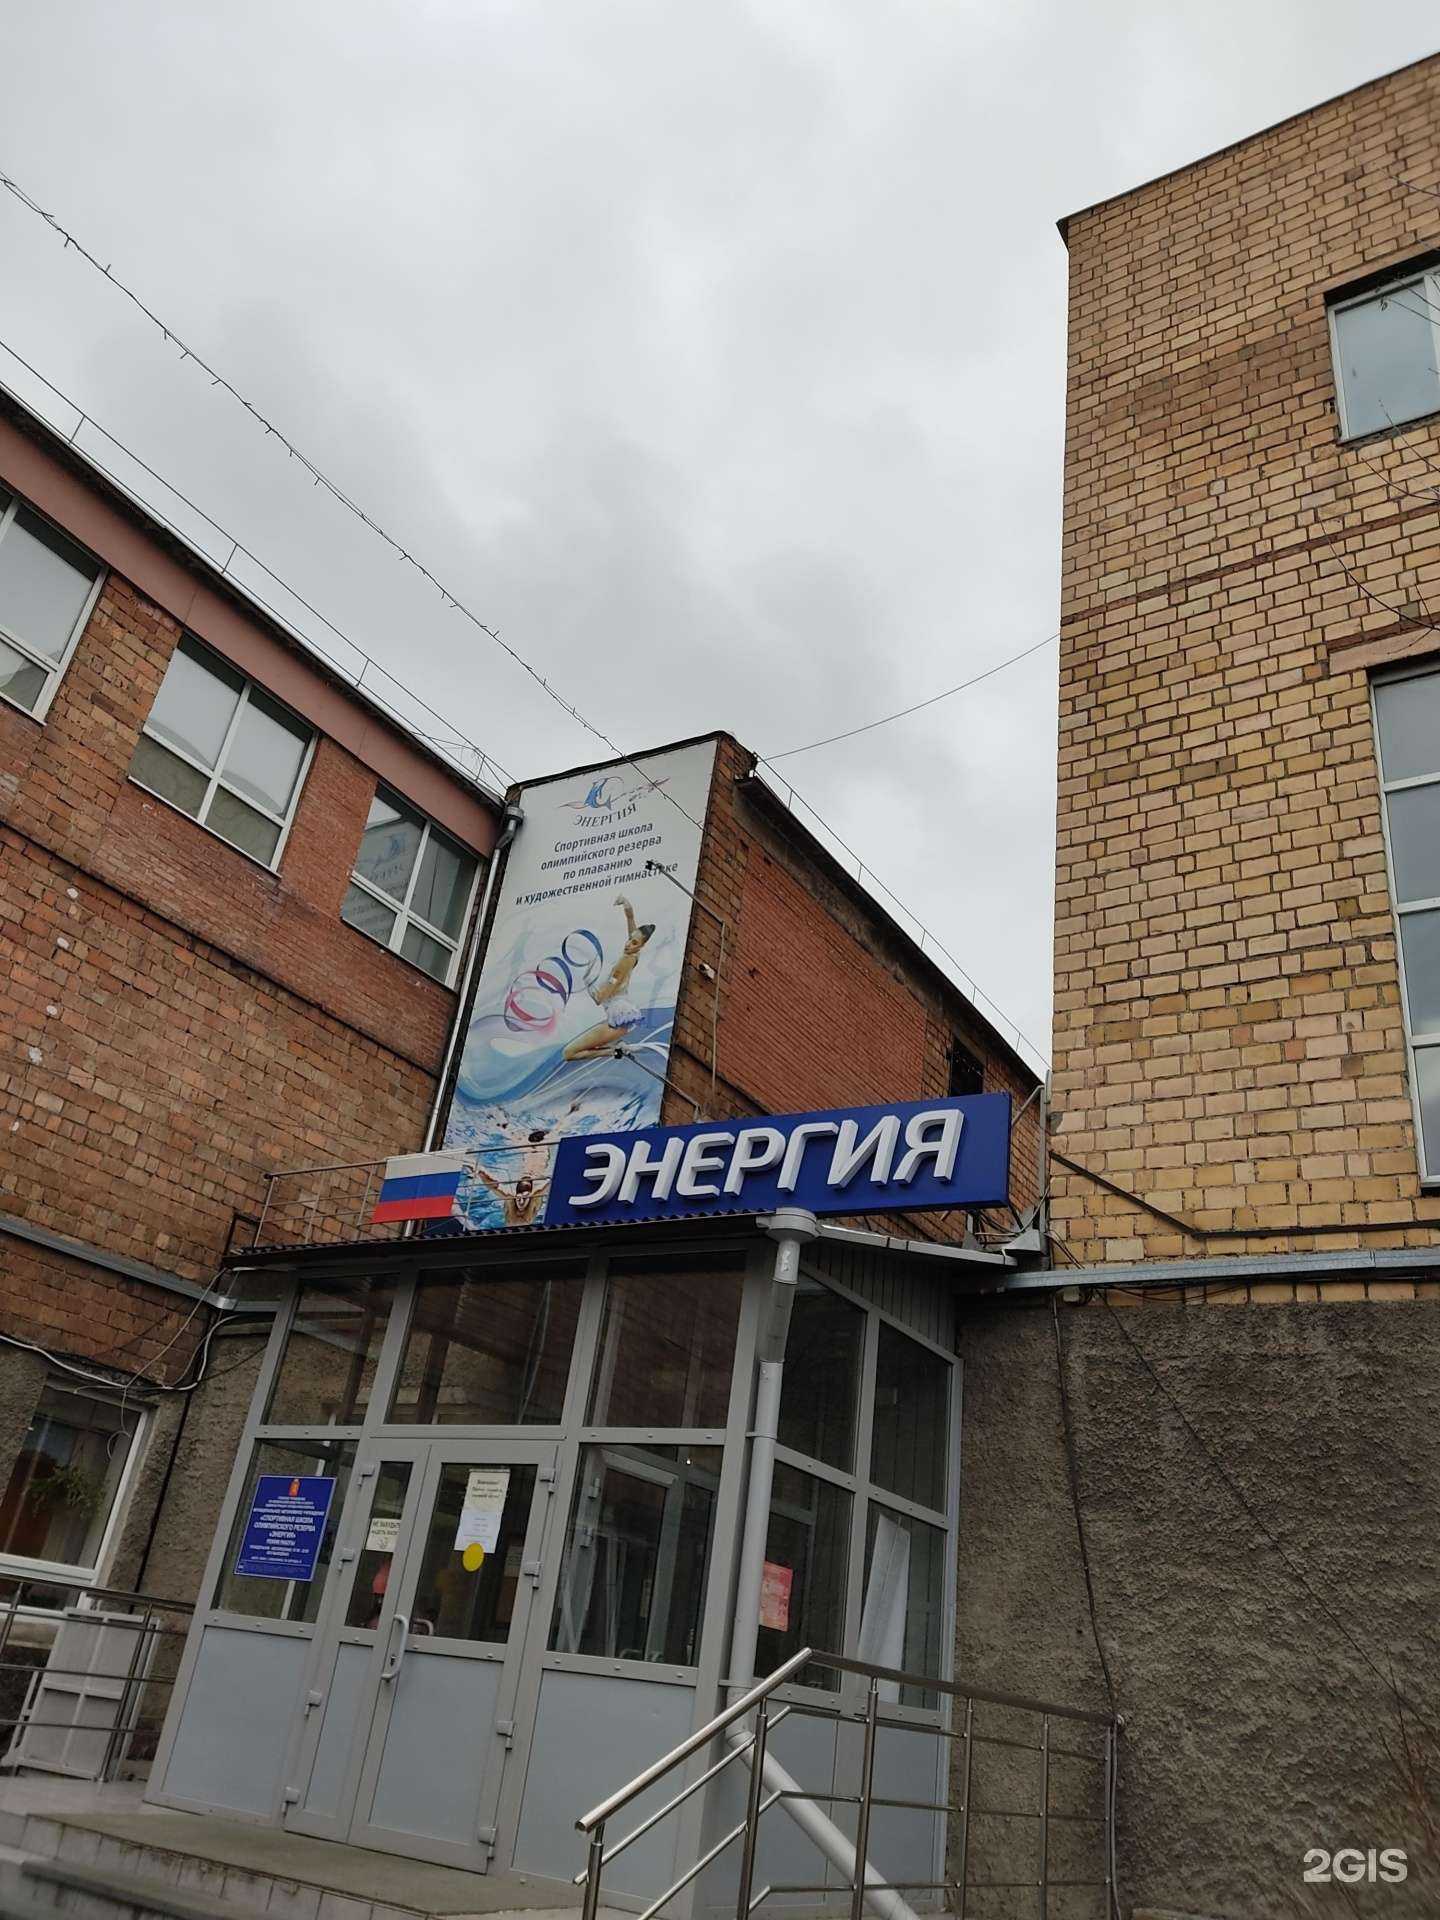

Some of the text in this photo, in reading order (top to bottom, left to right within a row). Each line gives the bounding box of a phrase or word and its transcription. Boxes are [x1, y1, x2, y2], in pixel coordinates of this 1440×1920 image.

[573, 802, 637, 827] ЭНЕРГИЯ
[554, 822, 653, 853] Спортивная школа
[540, 835, 662, 870] олимпийского резерва
[562, 857, 633, 880] по плаванию
[515, 895, 523, 905] и
[524, 877, 613, 905] художественной
[568, 1108, 965, 1206] ЭНЕРГИЯ
